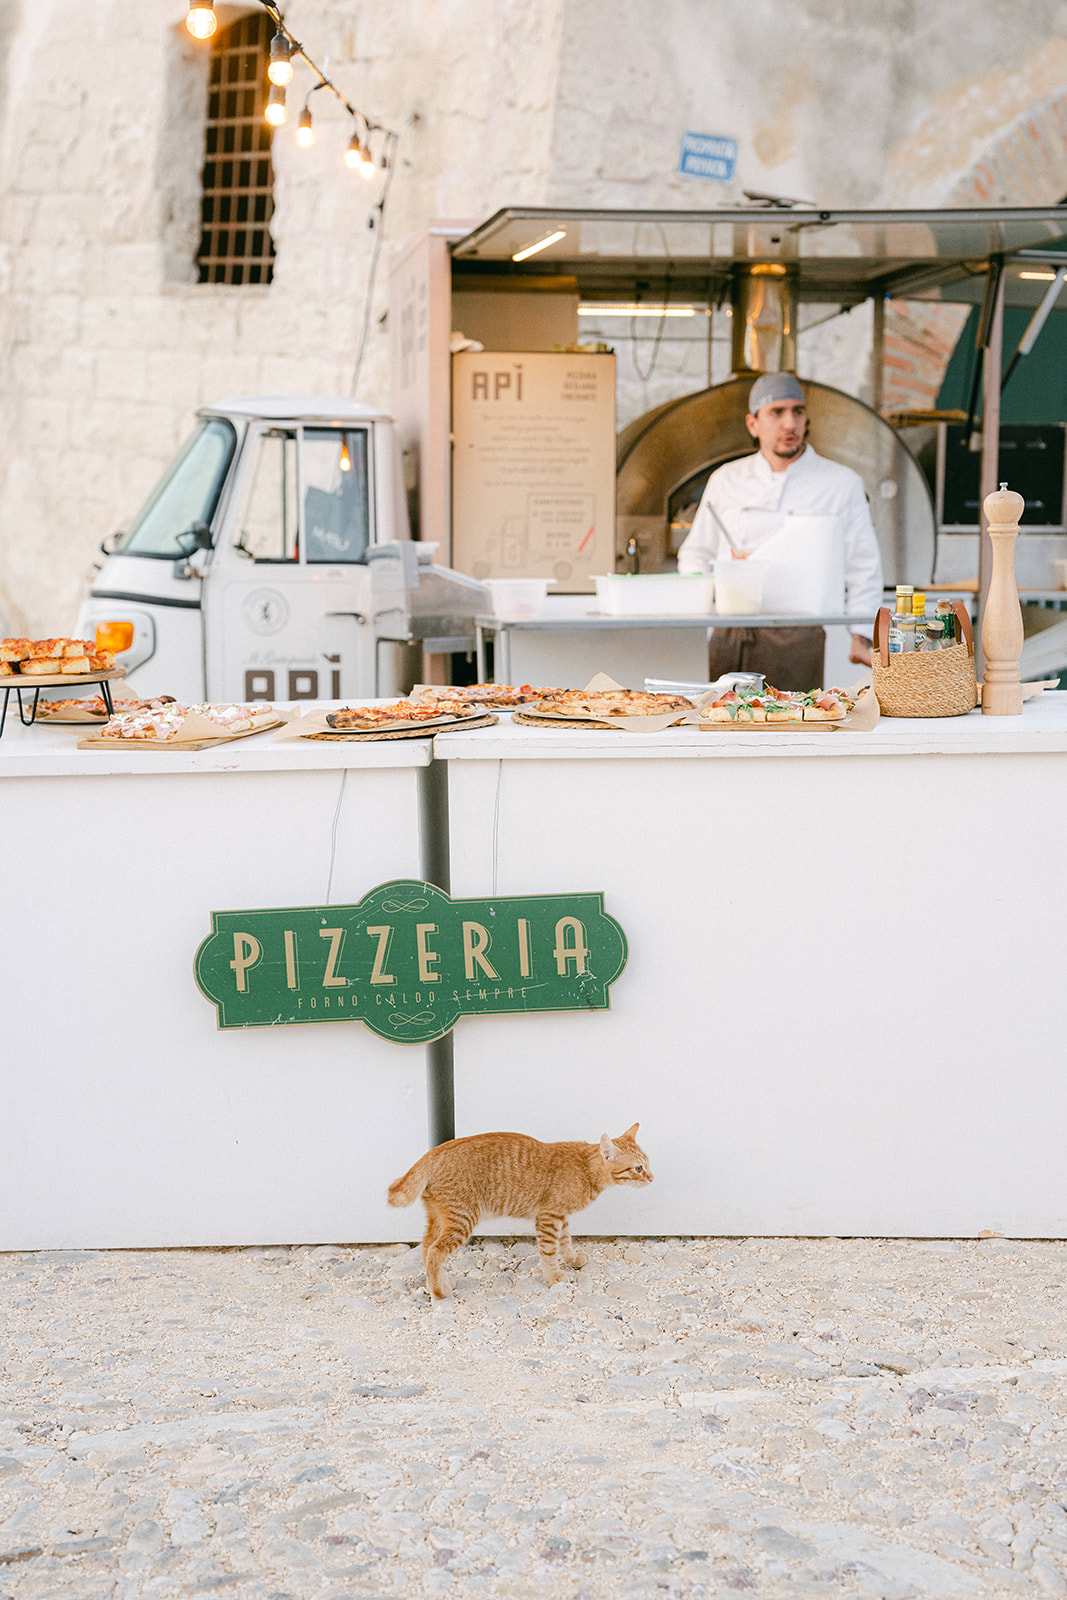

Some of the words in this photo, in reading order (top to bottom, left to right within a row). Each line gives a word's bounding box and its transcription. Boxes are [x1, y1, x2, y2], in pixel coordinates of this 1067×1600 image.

[229, 916, 592, 994] PIZZERIA
[298, 995, 358, 1009] FORNO
[375, 991, 435, 1005] CALDO
[452, 987, 528, 1001] SEMPRE
